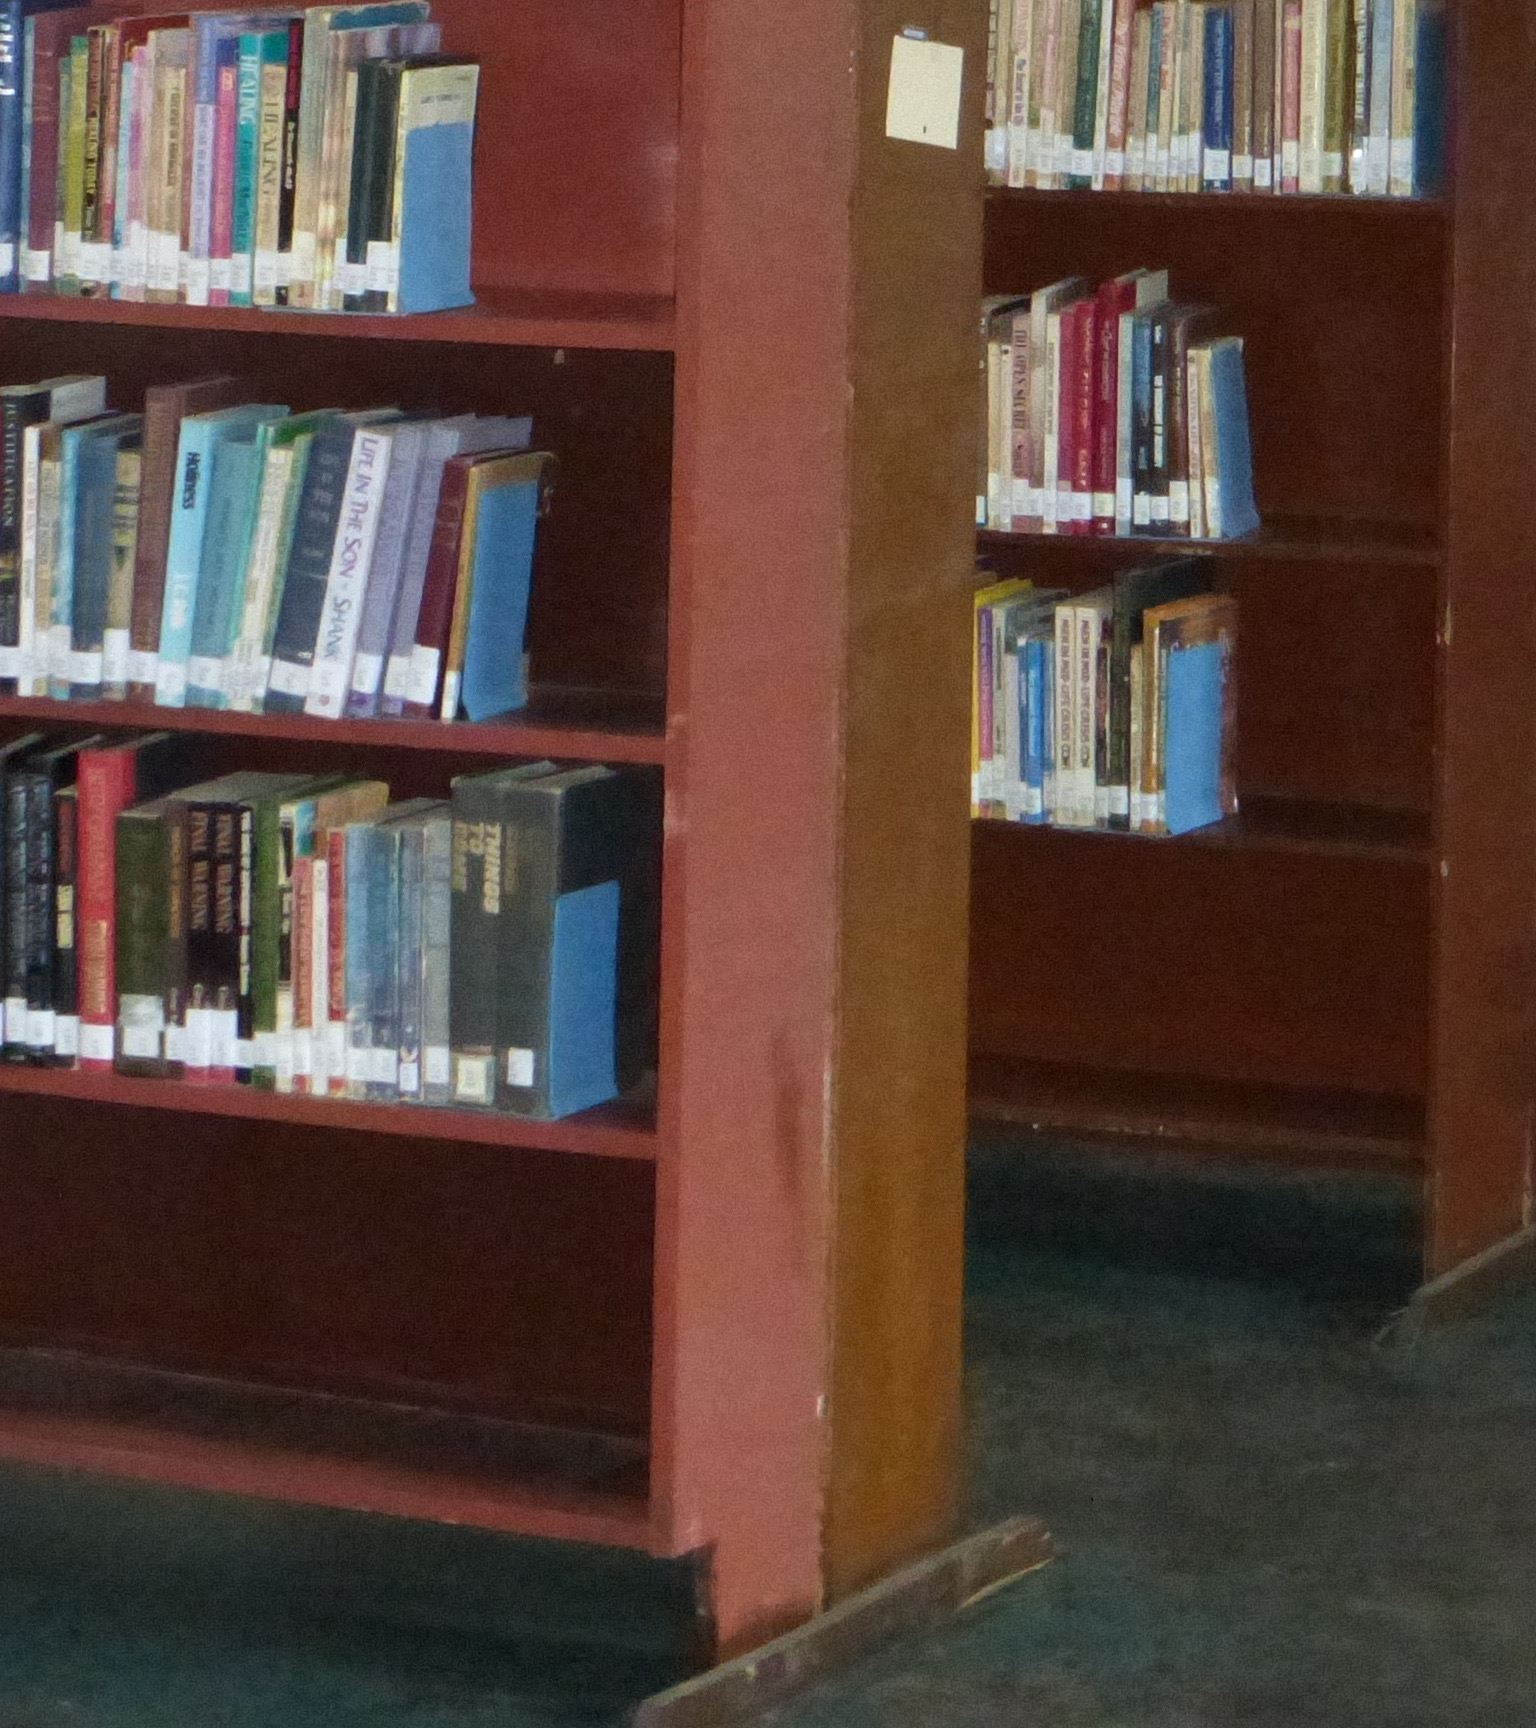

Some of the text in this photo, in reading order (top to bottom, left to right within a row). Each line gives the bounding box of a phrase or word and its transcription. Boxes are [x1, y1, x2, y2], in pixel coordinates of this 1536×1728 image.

[239, 54, 257, 125] HEALING
[2, 402, 19, 527] JUSTIFICATION
[358, 436, 381, 469] LIFE
[181, 451, 202, 511] Holiness
[354, 474, 373, 494] IN
[347, 500, 371, 531] THE
[339, 536, 362, 578] SON
